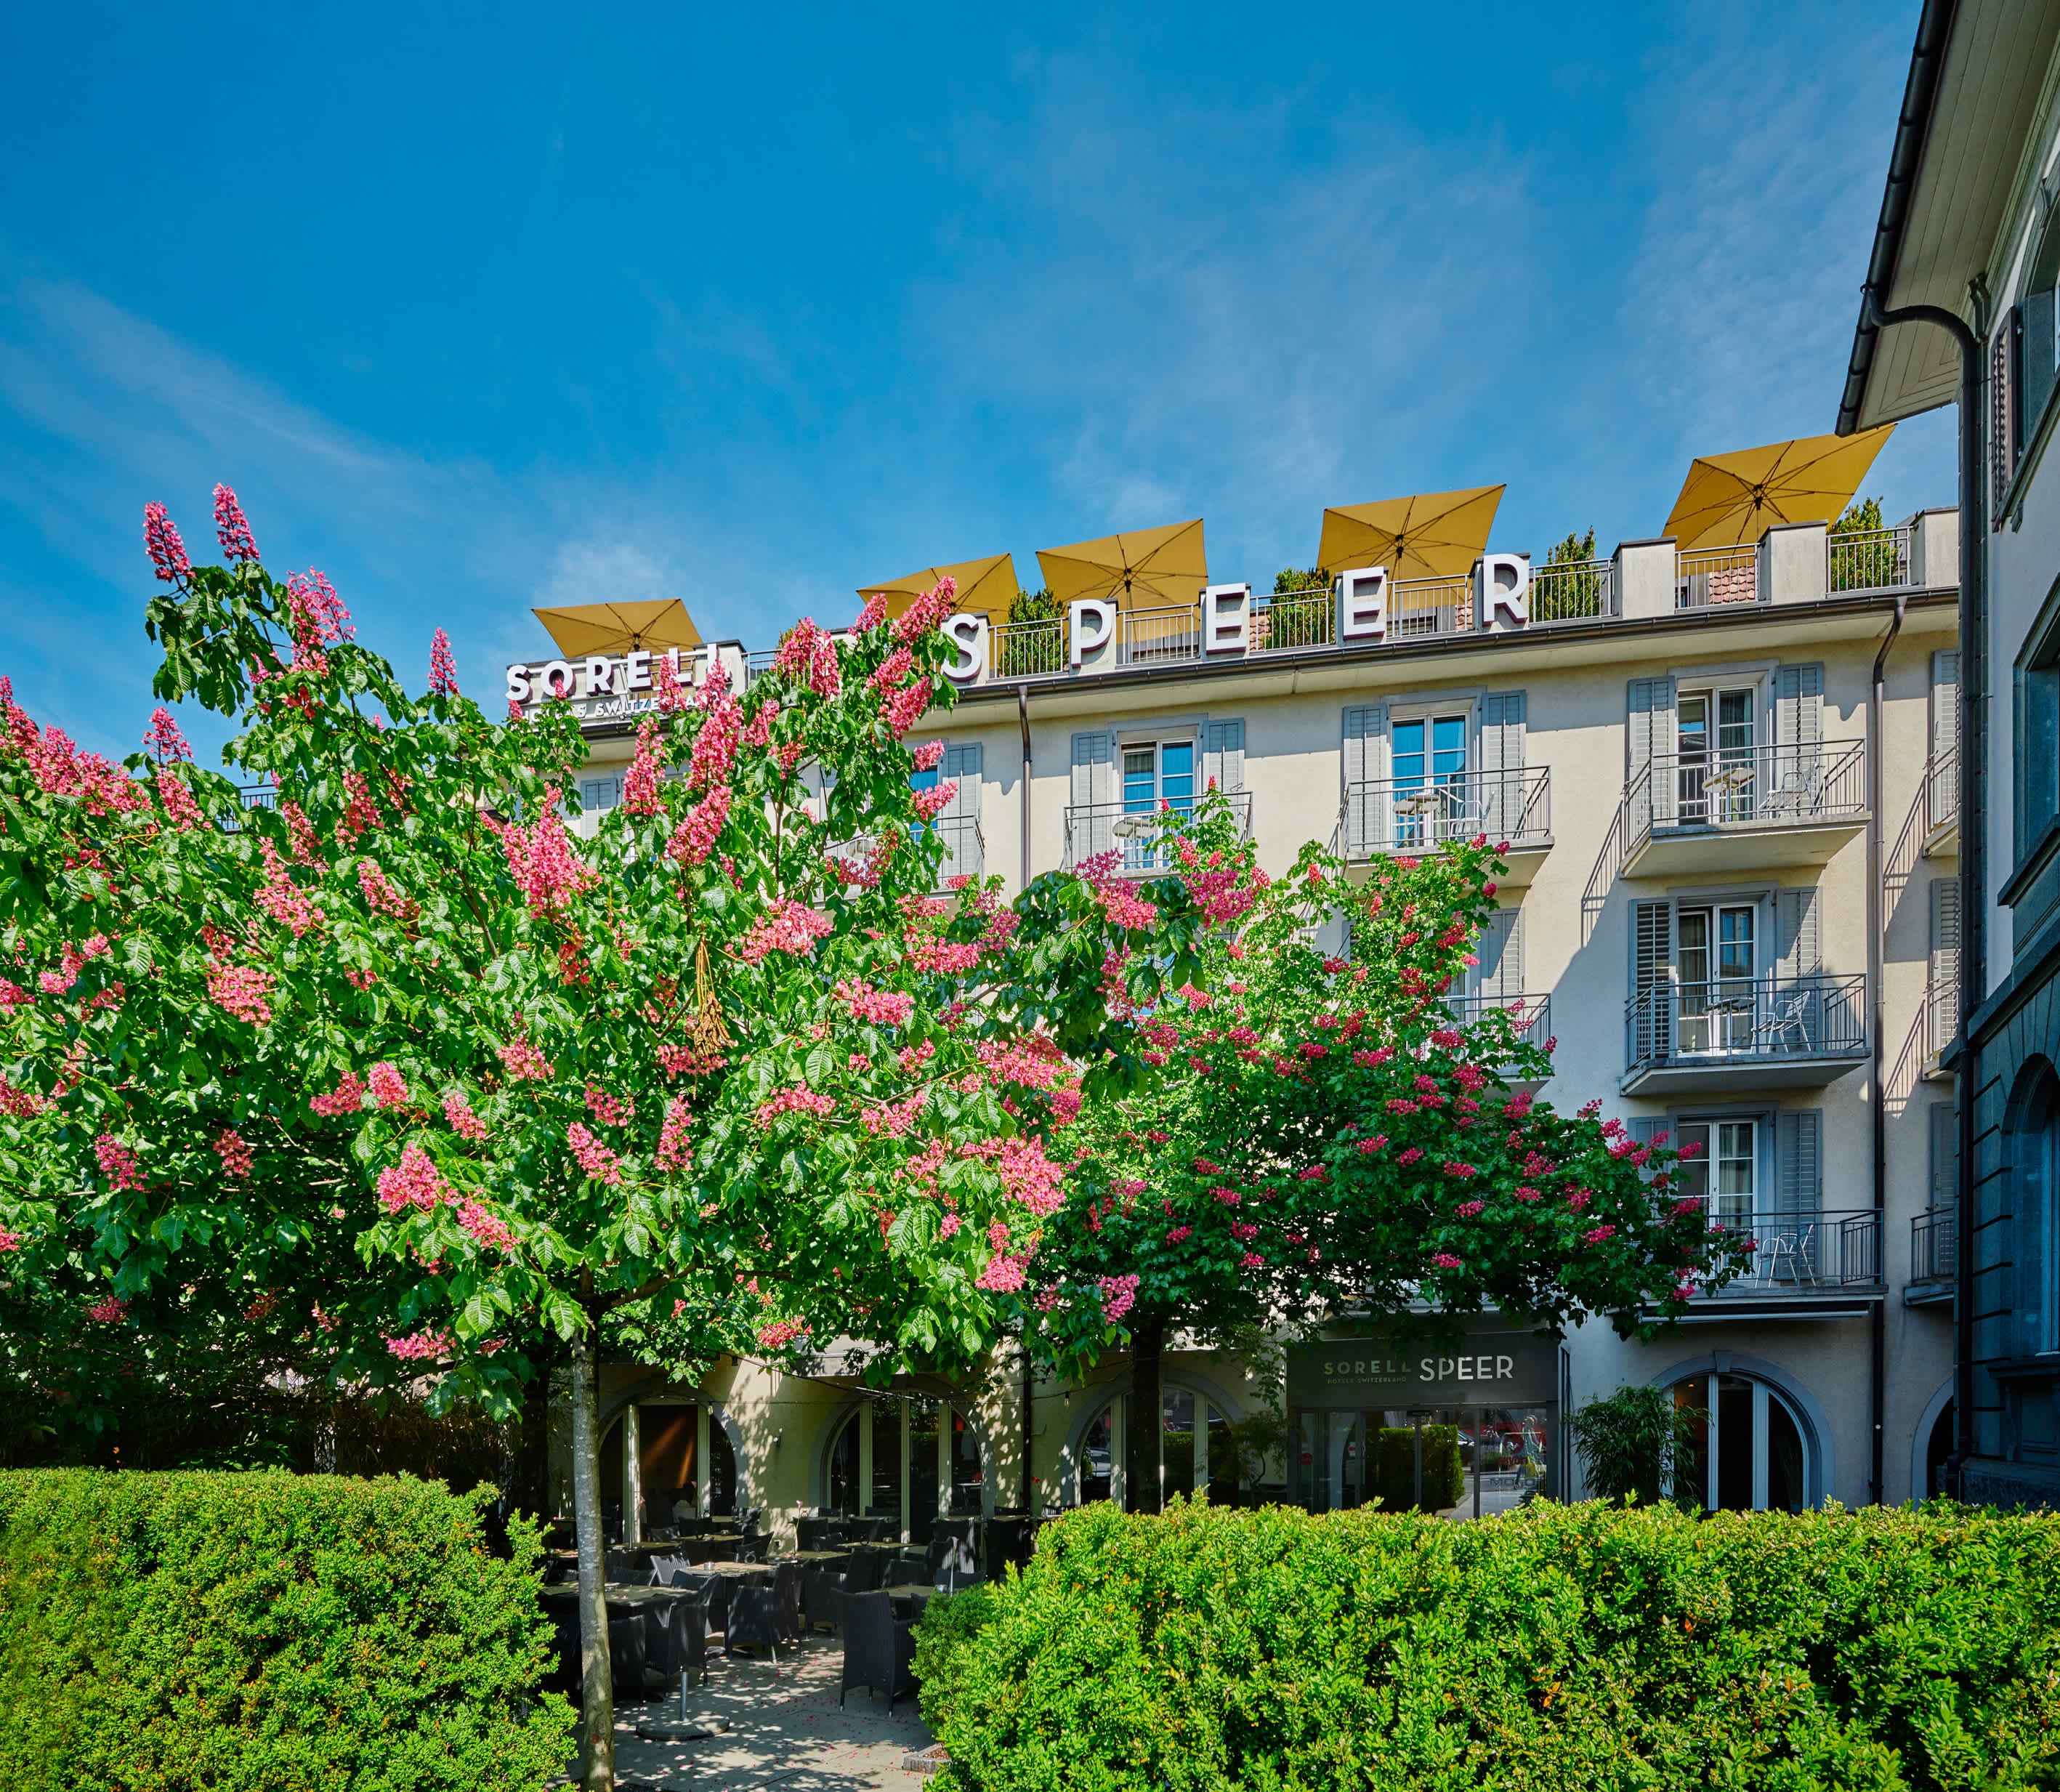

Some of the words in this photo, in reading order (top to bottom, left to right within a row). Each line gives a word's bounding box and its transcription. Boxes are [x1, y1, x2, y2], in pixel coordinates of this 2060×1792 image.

[942, 554, 1529, 681] SPEER
[1324, 1360, 1413, 1375] SORELL
[1419, 1355, 1514, 1381] SPEER
